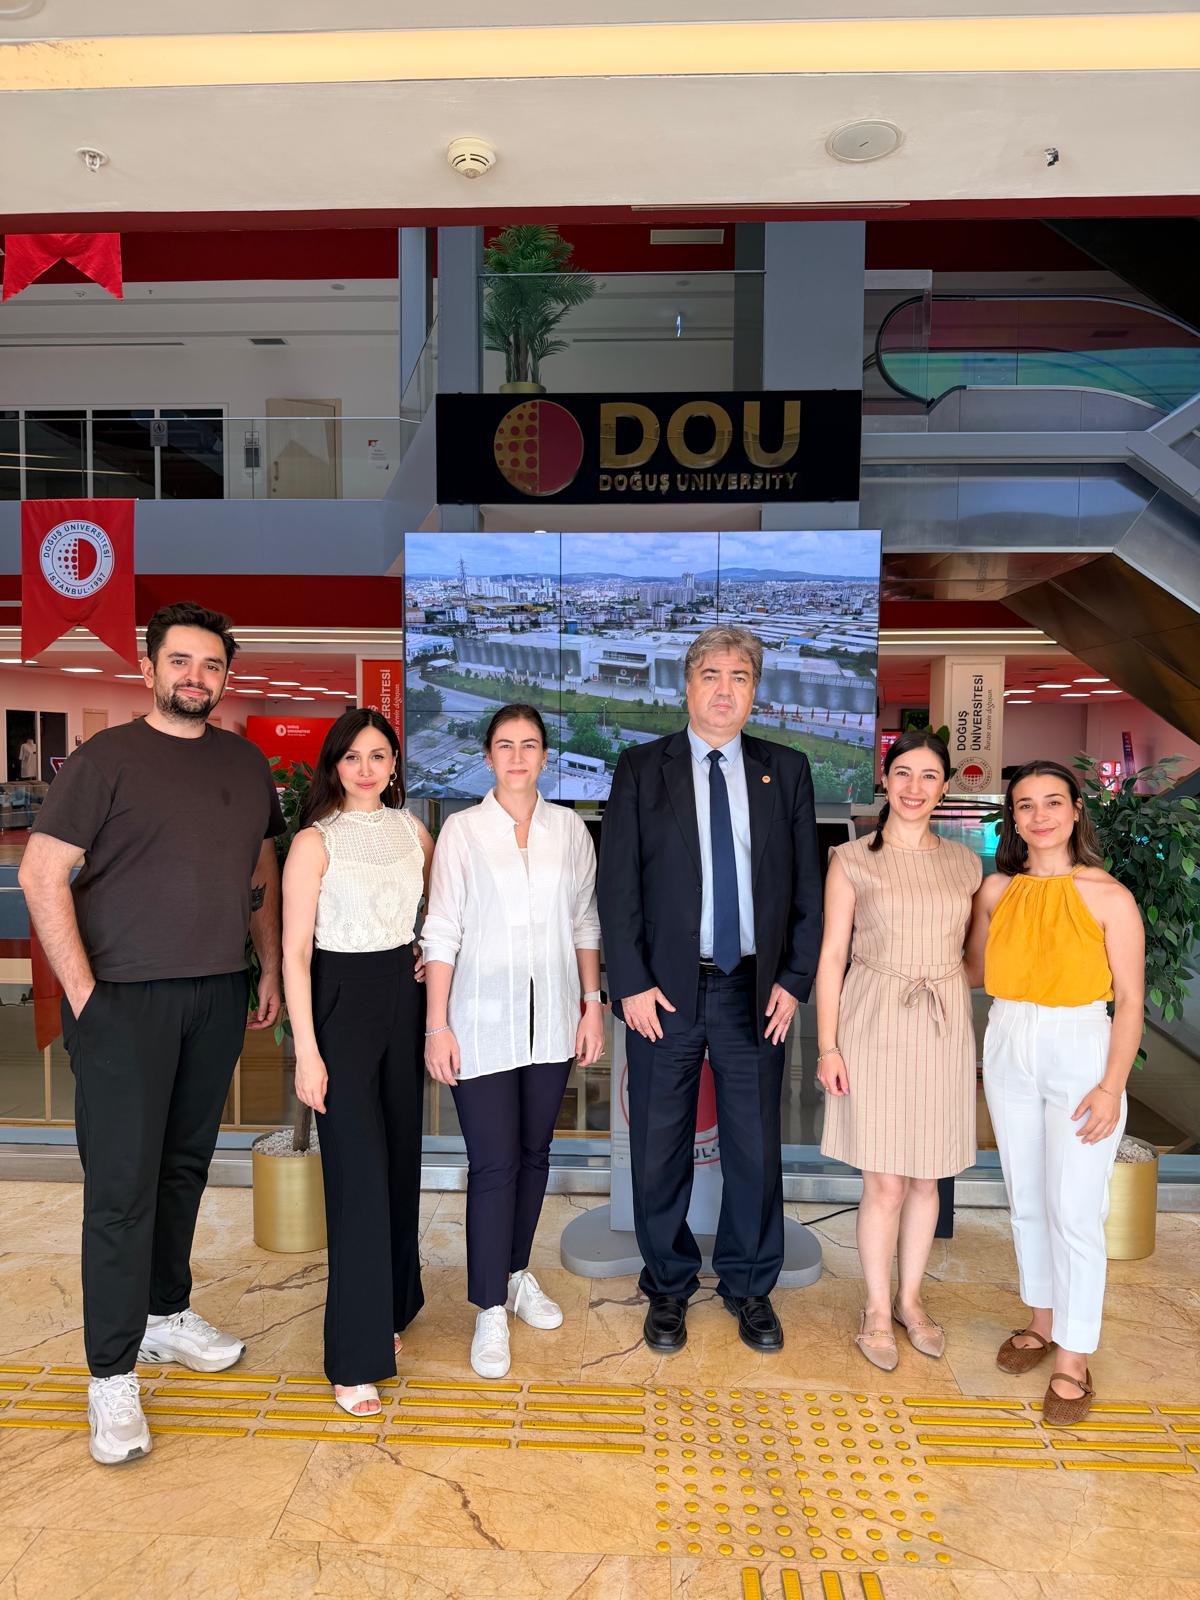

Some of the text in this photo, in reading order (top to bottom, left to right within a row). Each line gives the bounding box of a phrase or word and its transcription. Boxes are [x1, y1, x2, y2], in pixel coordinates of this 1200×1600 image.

[600, 400, 801, 469] DOU
[599, 472, 797, 495] DOĞUŞ UNIVERSITY
[43, 523, 111, 558] DOĞUŞ ÜNİVERSİTESİ
[380, 669, 391, 719] ERSİTESİ
[970, 674, 984, 751] ÜNİVERSİTESİ
[956, 710, 969, 751] DOĞUŞ
